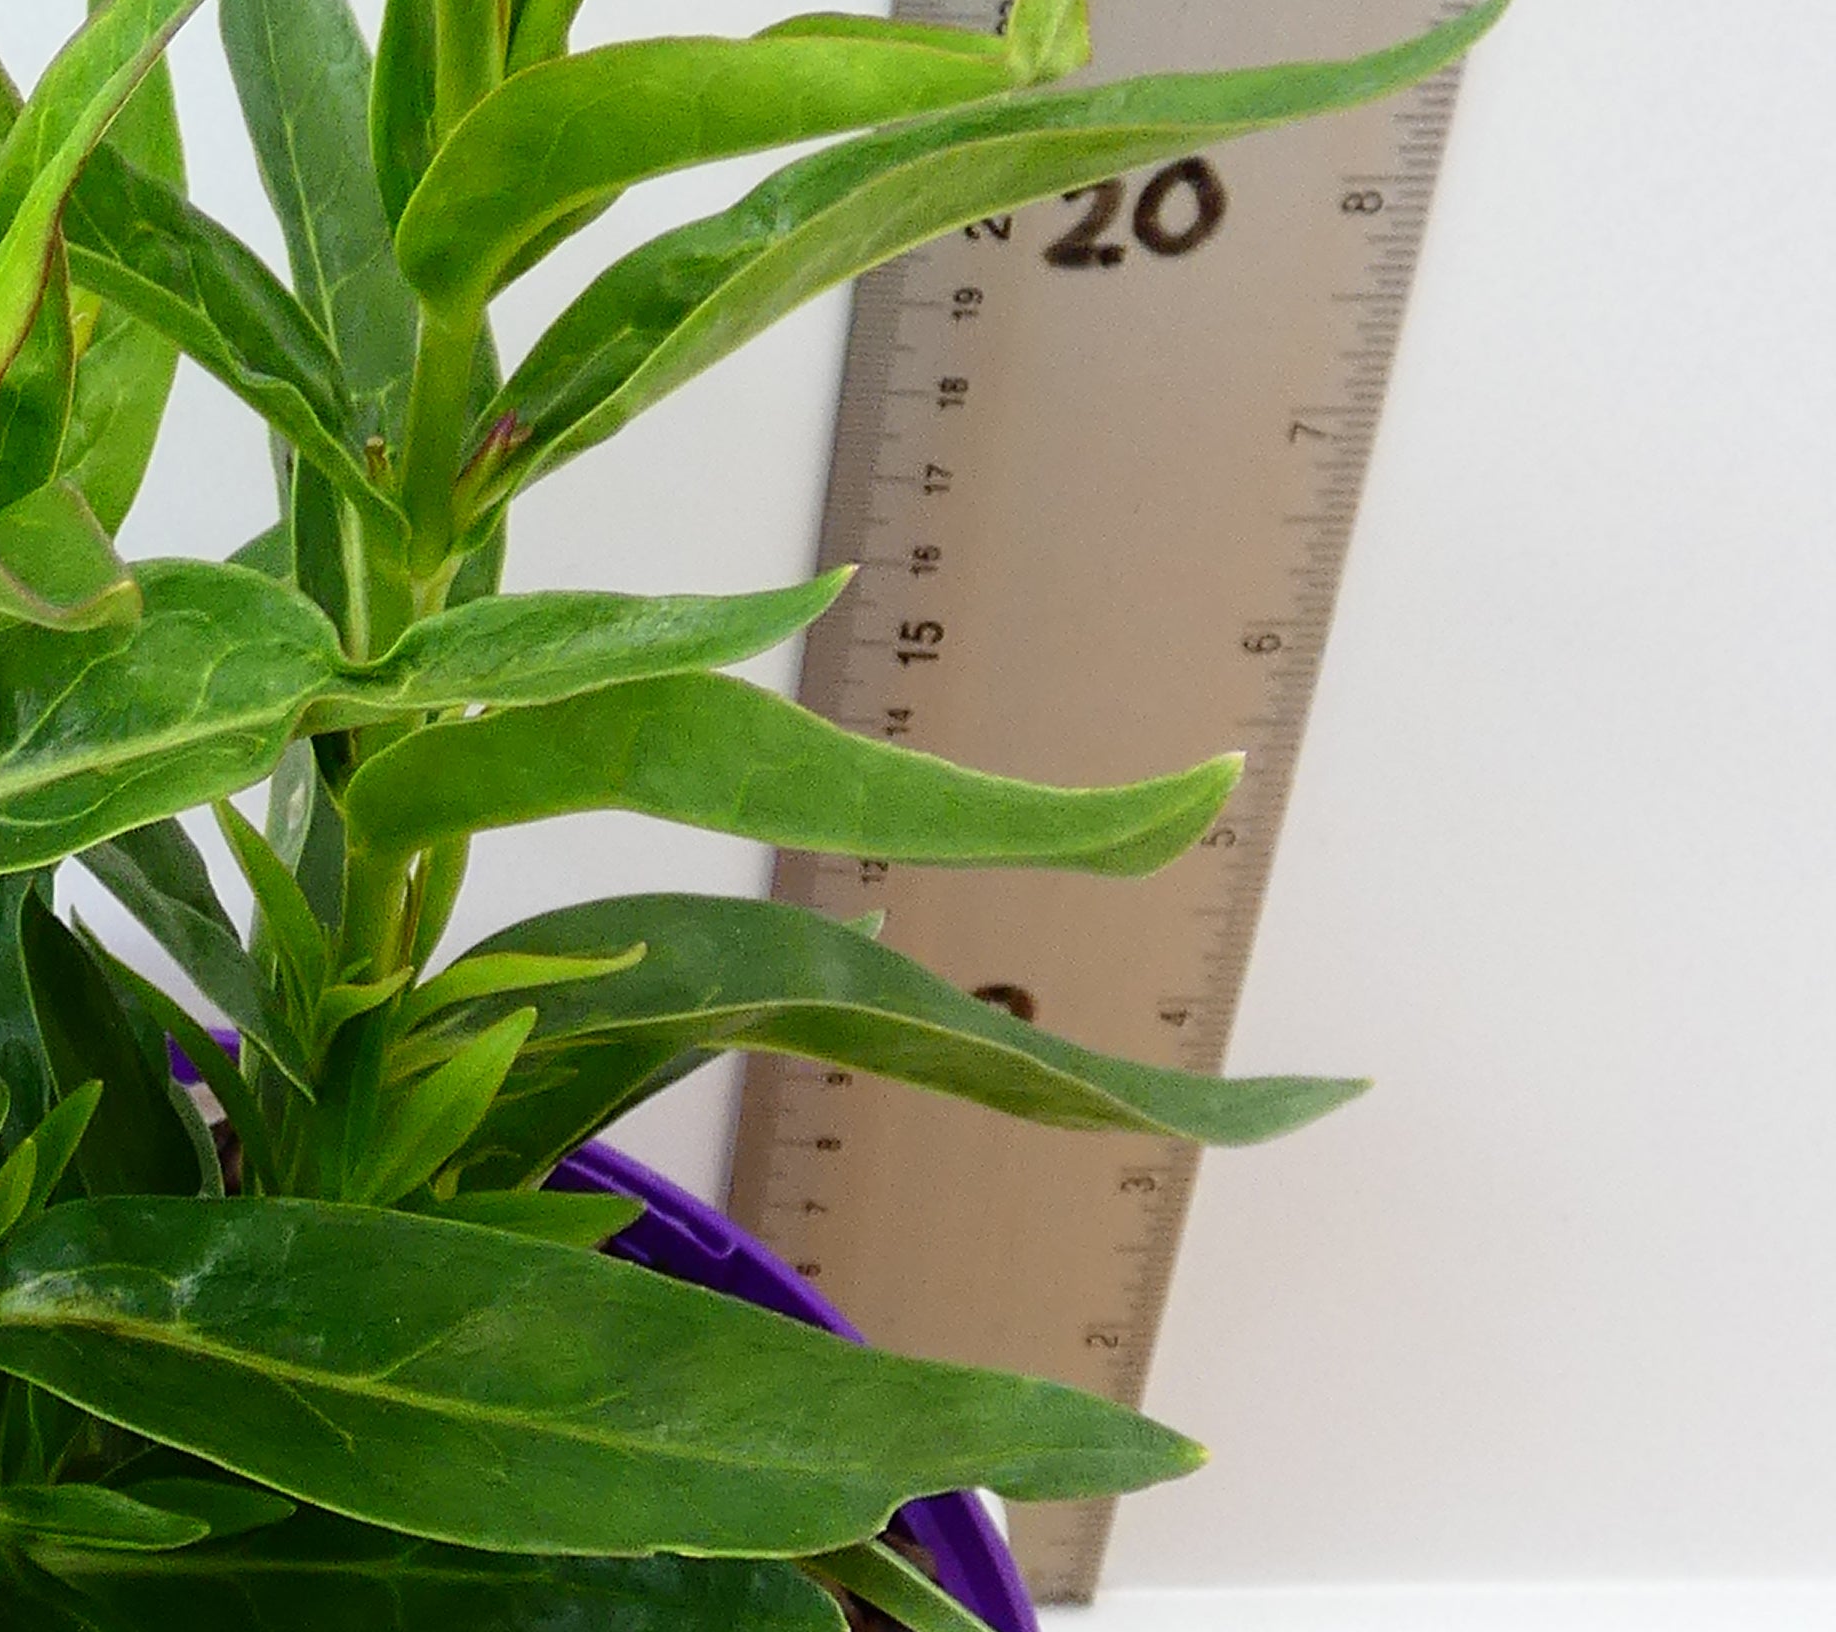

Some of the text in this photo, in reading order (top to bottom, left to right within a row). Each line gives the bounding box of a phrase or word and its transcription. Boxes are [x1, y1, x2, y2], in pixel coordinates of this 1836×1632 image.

[1042, 155, 1226, 268] 20
[1342, 191, 1383, 213] 8
[953, 286, 984, 321] 19
[938, 377, 969, 410] 18
[1290, 422, 1327, 442] 7
[924, 464, 954, 496] 17
[911, 545, 942, 575] 16
[897, 620, 944, 666] 15
[1243, 634, 1282, 654] 6
[886, 708, 913, 735] 14
[1120, 1175, 1156, 1194] 3
[1086, 1333, 1119, 1349] 2
